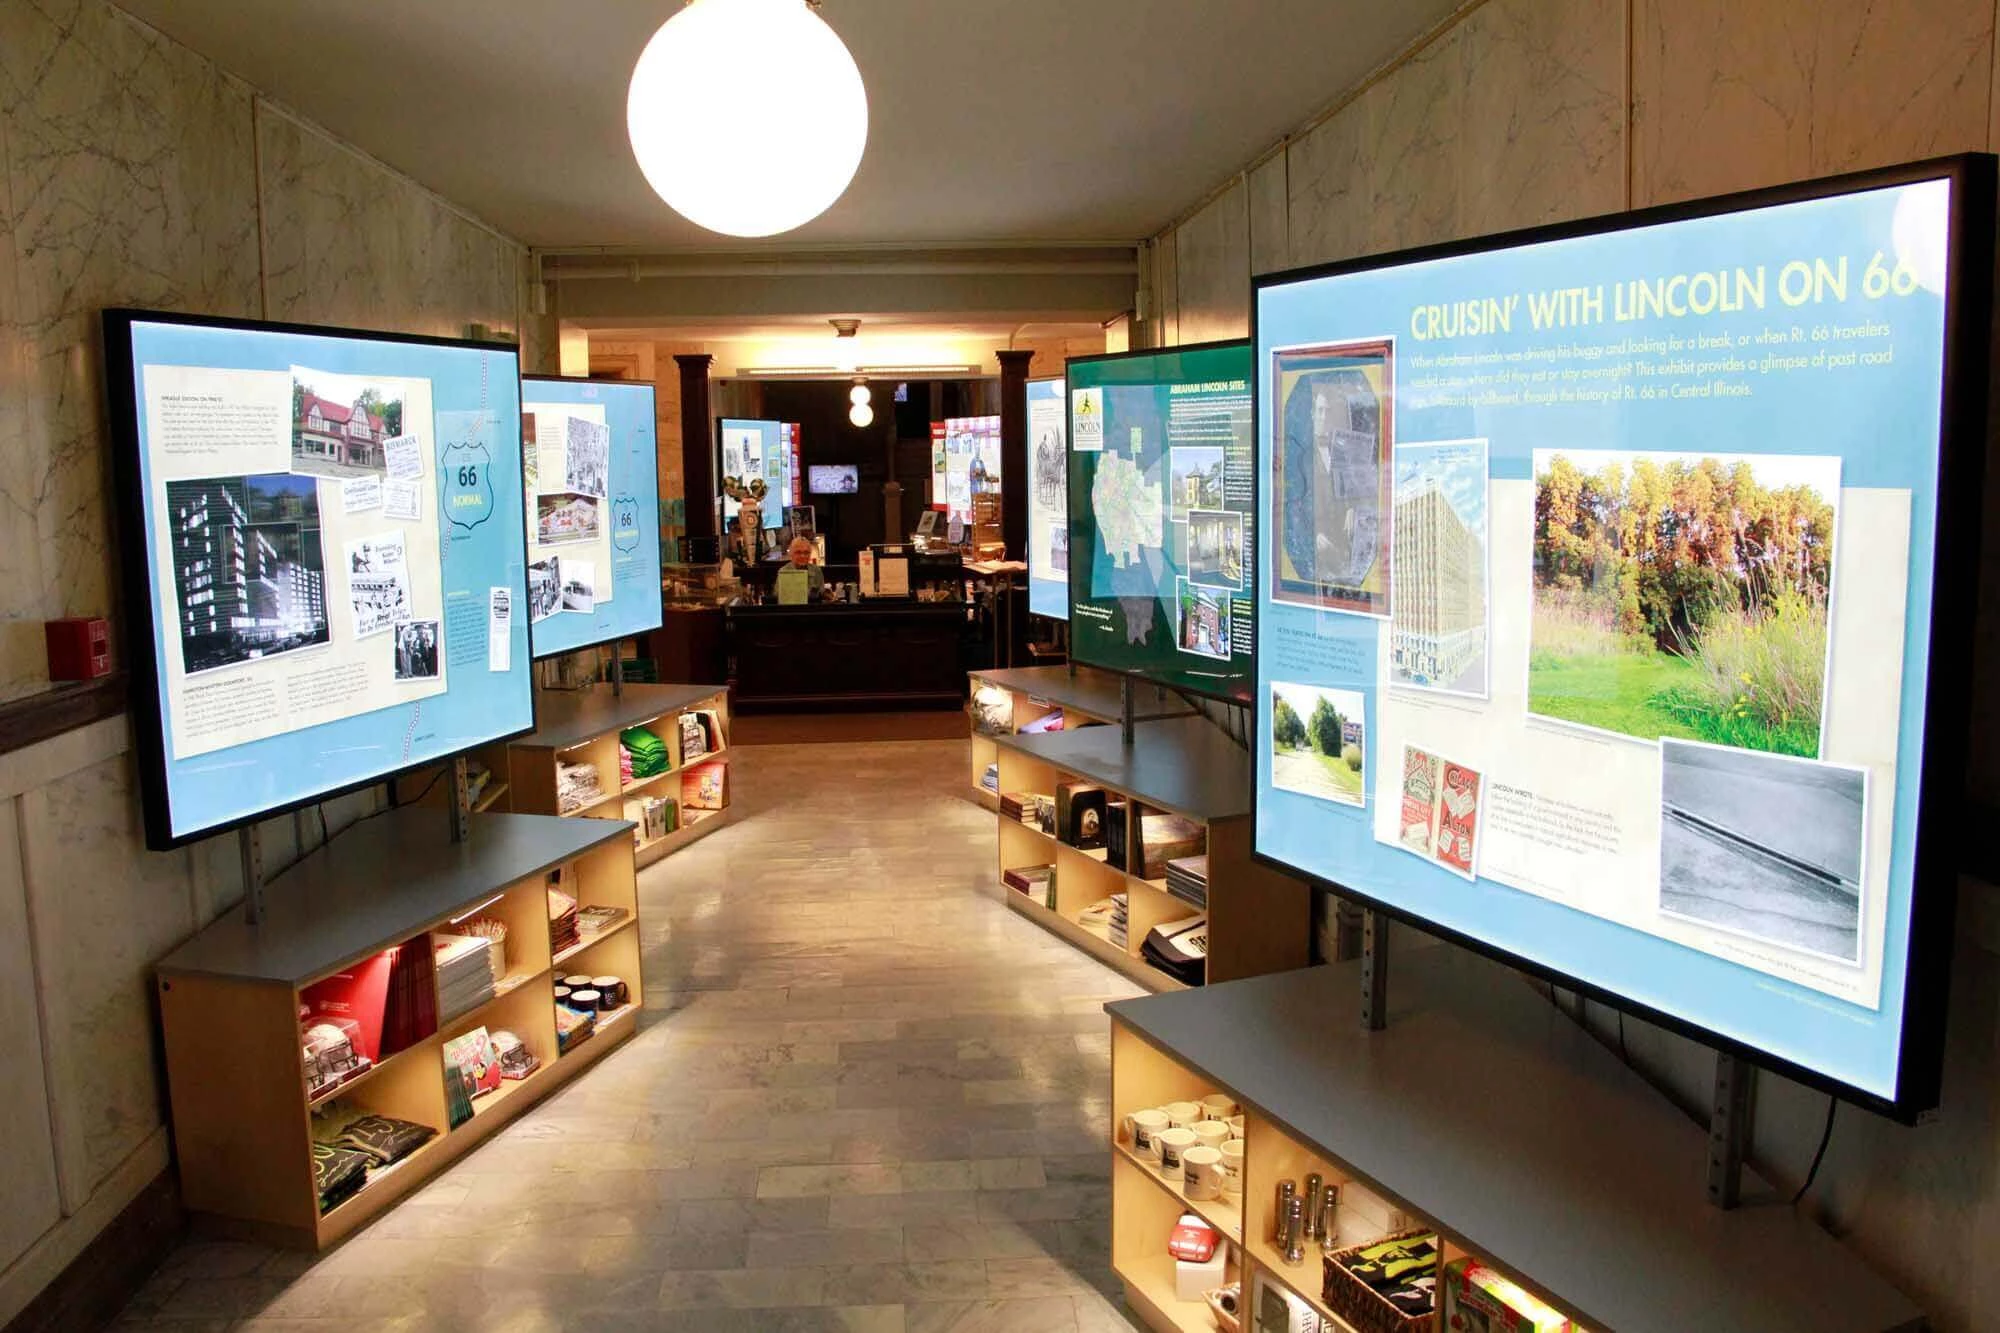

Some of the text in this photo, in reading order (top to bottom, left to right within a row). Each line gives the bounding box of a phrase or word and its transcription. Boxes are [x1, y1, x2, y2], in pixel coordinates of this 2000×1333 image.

[1528, 286, 1603, 331] WITH
[1615, 265, 1765, 321] LINCOLN
[1778, 256, 1847, 307] ON
[1863, 250, 1919, 299] 66
[1409, 353, 1435, 368] When
[1505, 352, 1521, 361] was
[1524, 345, 1556, 363] driving
[1573, 342, 1603, 360] buggy
[1605, 340, 1625, 354] and
[1628, 336, 1666, 355] looking
[1669, 335, 1684, 350] for
[1687, 338, 1696, 349] a
[1738, 335, 1751, 346] or
[1755, 328, 1787, 344] when
[1791, 327, 1806, 343] Rt.
[1811, 325, 1829, 341] 66
[1833, 320, 1890, 340] travelers
[1635, 360, 1654, 376] This
[1658, 357, 1694, 375] exhibit
[1697, 356, 1745, 377] provides
[1748, 361, 1757, 371] a
[1760, 352, 1808, 374] glimpse
[1811, 349, 1826, 366] of
[1828, 351, 1856, 372] past
[1860, 344, 1893, 365] road
[1170, 380, 1245, 394] ABRAHAM LINCOLN SITES
[1576, 387, 1608, 404] history
[1611, 384, 1622, 400] of
[1640, 384, 1655, 399] 66
[1658, 385, 1668, 398] in
[1671, 380, 1710, 398] Central
[1714, 380, 1752, 397] Illinois.
[459, 465, 477, 487] 66
[453, 494, 482, 507] NORMAL
[621, 512, 632, 527] 66
